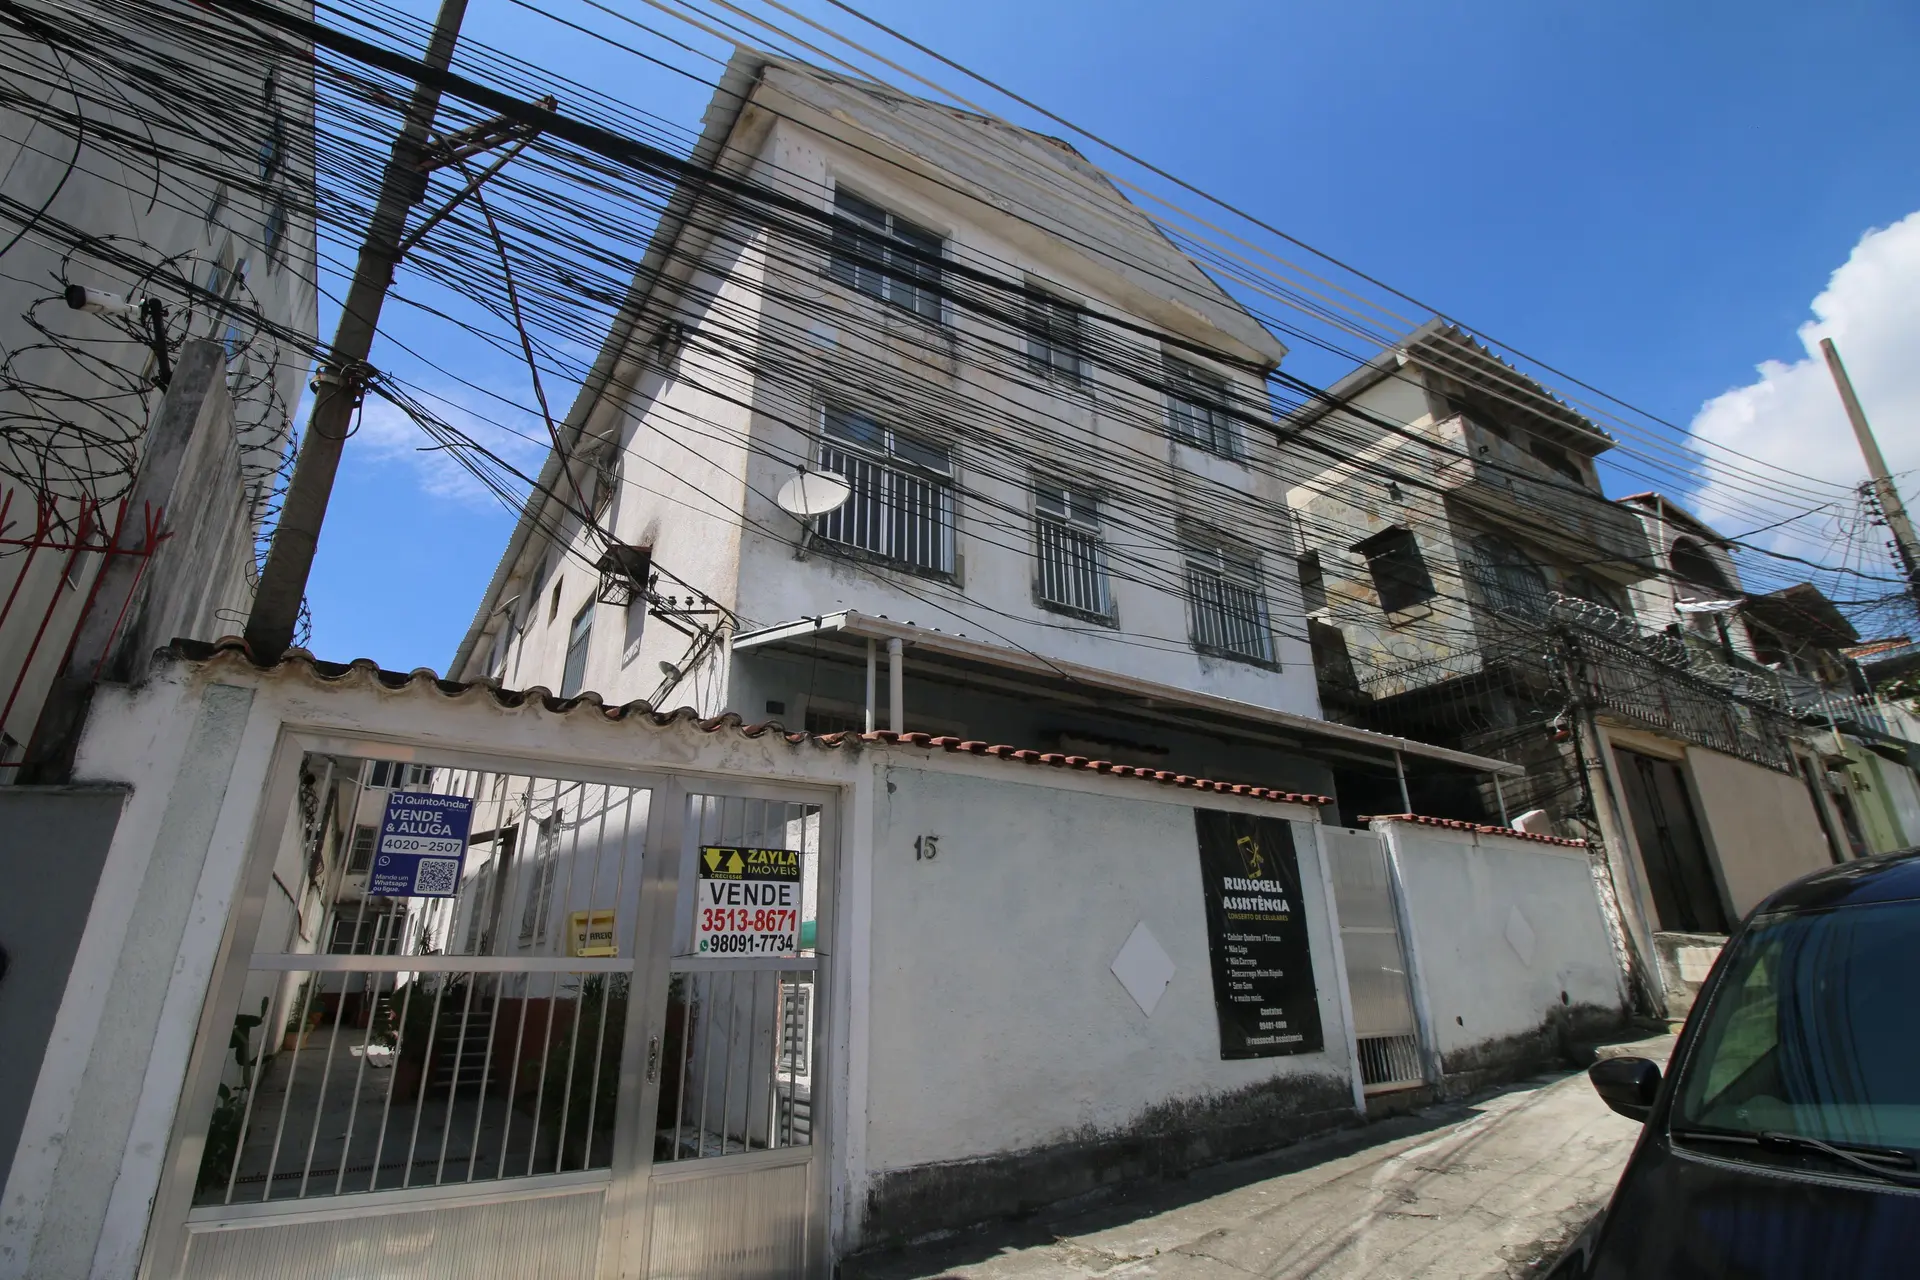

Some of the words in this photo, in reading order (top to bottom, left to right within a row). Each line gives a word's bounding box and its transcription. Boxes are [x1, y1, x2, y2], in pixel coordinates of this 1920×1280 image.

[405, 796, 469, 809] QuintoAndar
[390, 809, 443, 823] VENDE
[386, 823, 395, 833] &
[397, 822, 452, 836] ALUGA
[384, 839, 460, 852] 4020-2507
[914, 835, 939, 861] 15
[747, 849, 797, 866] ZAYLA
[747, 864, 798, 876] IMÓVEIS
[374, 879, 408, 887] Whatsapp
[1223, 877, 1283, 893] RUSSOCELL
[710, 882, 792, 906] VENDE
[1223, 895, 1291, 912] ASSISTÊNCIA
[701, 908, 797, 932] 3513-8671
[579, 931, 613, 942] CRREIO
[710, 934, 794, 953] 98091-7734
